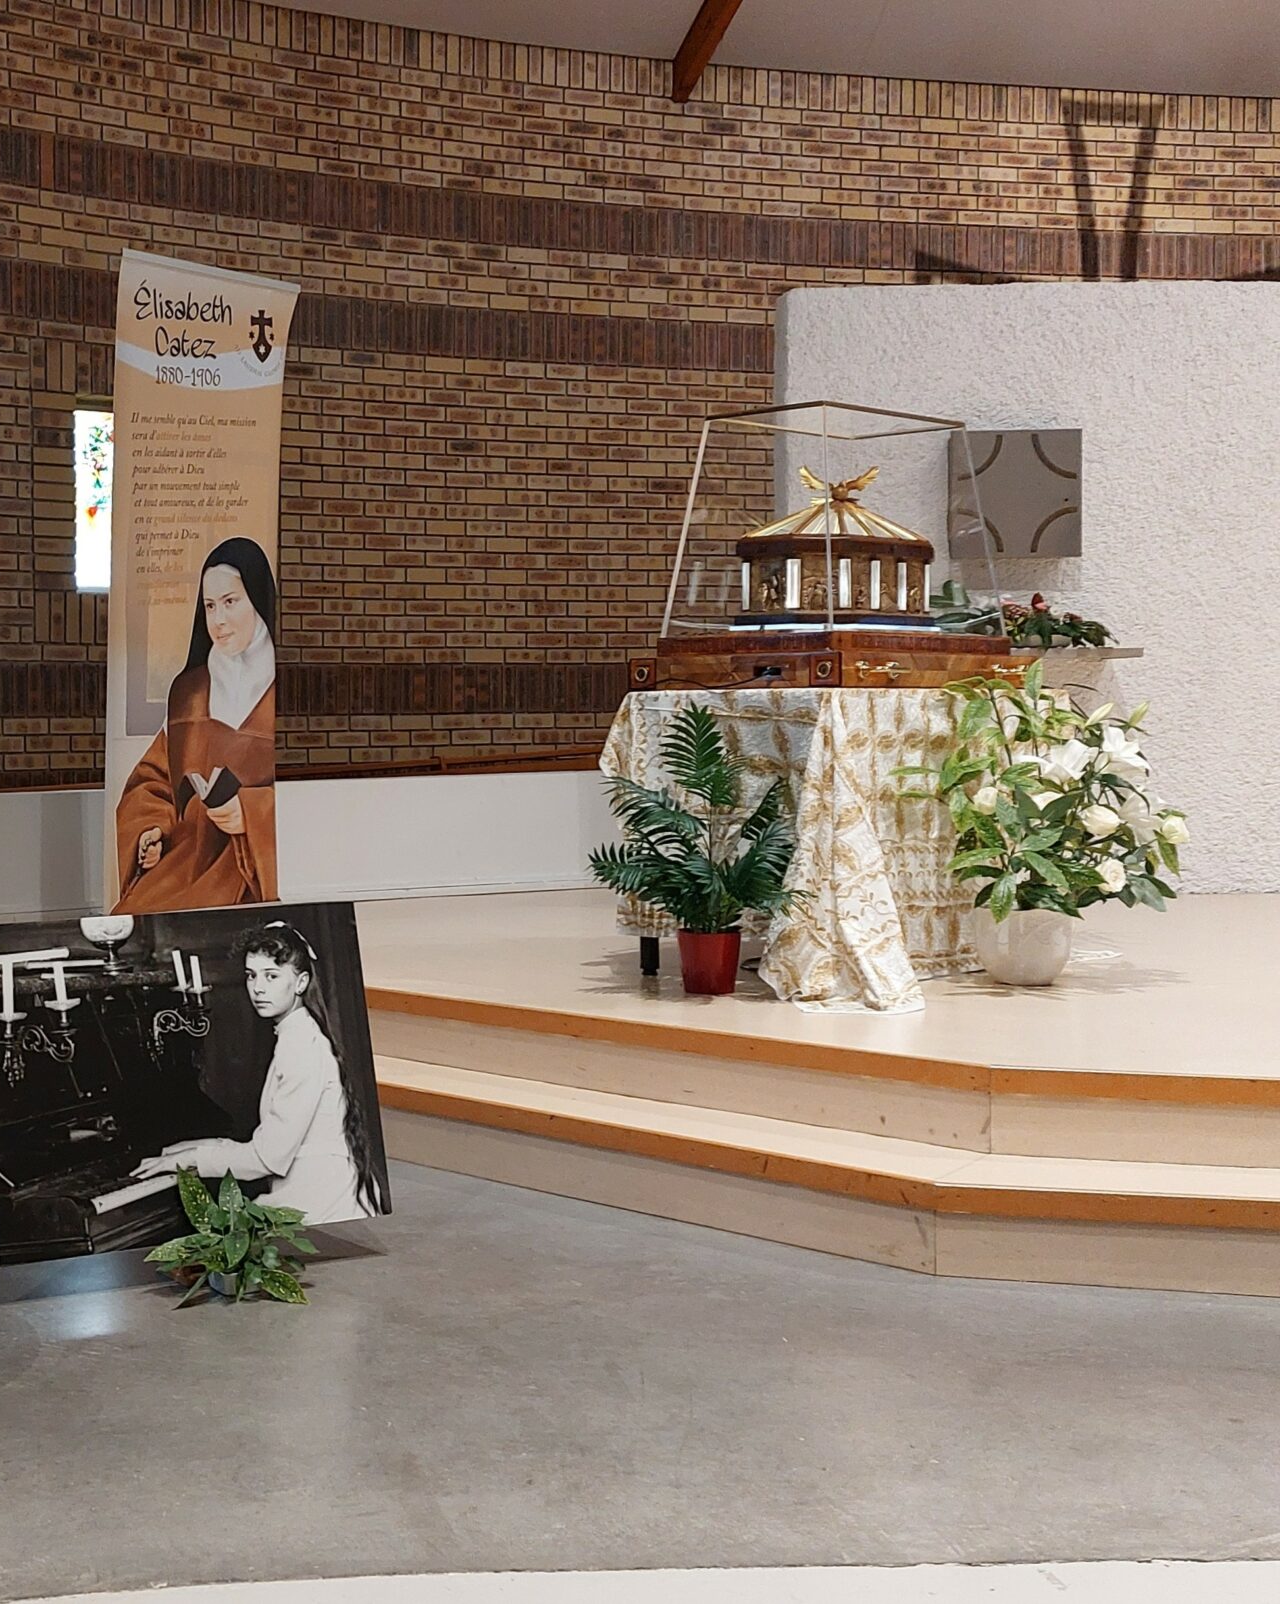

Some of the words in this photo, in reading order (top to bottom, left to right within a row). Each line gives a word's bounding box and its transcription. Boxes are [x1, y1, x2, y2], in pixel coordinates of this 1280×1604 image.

[134, 280, 233, 326] Élisabeth
[155, 326, 217, 359] Catez
[155, 365, 221, 387] 1880-1906
[130, 412, 139, 423] Il
[141, 416, 152, 424] me
[154, 413, 176, 424] semble
[177, 414, 197, 428] qu'au
[199, 414, 216, 427] Ciel,
[217, 418, 228, 426] ma
[229, 416, 256, 427] mission
[131, 432, 147, 440] sera
[181, 431, 191, 441] les
[132, 449, 142, 457] en
[144, 446, 154, 457] les
[155, 447, 177, 458] aidant
[179, 448, 184, 458] à
[186, 448, 206, 458] sortir
[207, 447, 227, 458] d'elles
[131, 465, 151, 478] pour
[152, 463, 178, 474] adhérer
[179, 465, 185, 474] à
[186, 463, 205, 474] Dieu
[132, 482, 149, 494] par
[160, 481, 201, 491] mouvement
[203, 482, 217, 490] tout
[219, 480, 240, 495] simple
[134, 499, 142, 507] et
[143, 498, 158, 507] tout
[198, 499, 205, 507] et
[206, 496, 214, 507] de
[215, 496, 224, 507] les
[225, 496, 249, 511] garder
[134, 516, 145, 524] en
[146, 516, 152, 524] ce
[153, 513, 176, 526] grand
[177, 512, 201, 523] silence
[135, 531, 148, 544] qui
[149, 531, 173, 545] permet
[174, 530, 179, 539] à
[181, 528, 200, 539] Dieu
[136, 546, 145, 557] de
